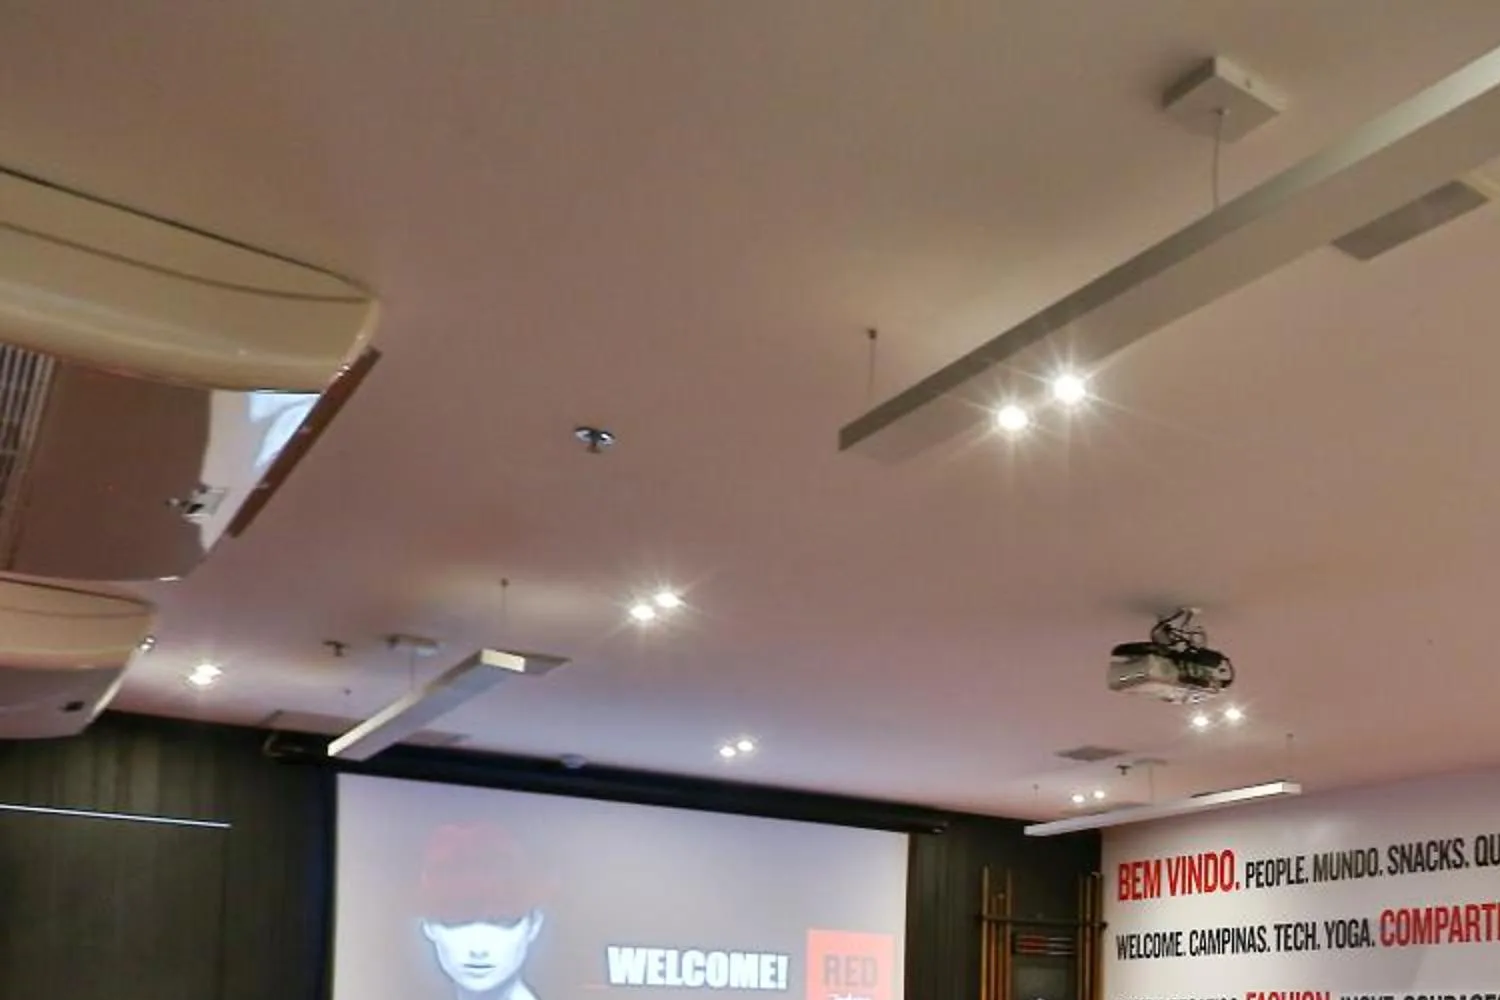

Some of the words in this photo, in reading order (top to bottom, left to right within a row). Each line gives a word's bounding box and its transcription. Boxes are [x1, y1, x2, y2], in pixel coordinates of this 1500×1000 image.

[1118, 859, 1162, 901] BEM
[1167, 850, 1239, 896] VINDO.
[1246, 856, 1308, 888] PEOPLE.
[1313, 848, 1383, 882] MUNDO.
[1388, 838, 1469, 875] SNACKS.
[1115, 932, 1186, 960] WELCOME.
[1190, 926, 1270, 956] CAMPINAS.
[1274, 922, 1320, 951] TECH.
[1324, 919, 1375, 948] YOGA.
[606, 945, 790, 990] WELCOME!
[823, 954, 878, 989] RED
